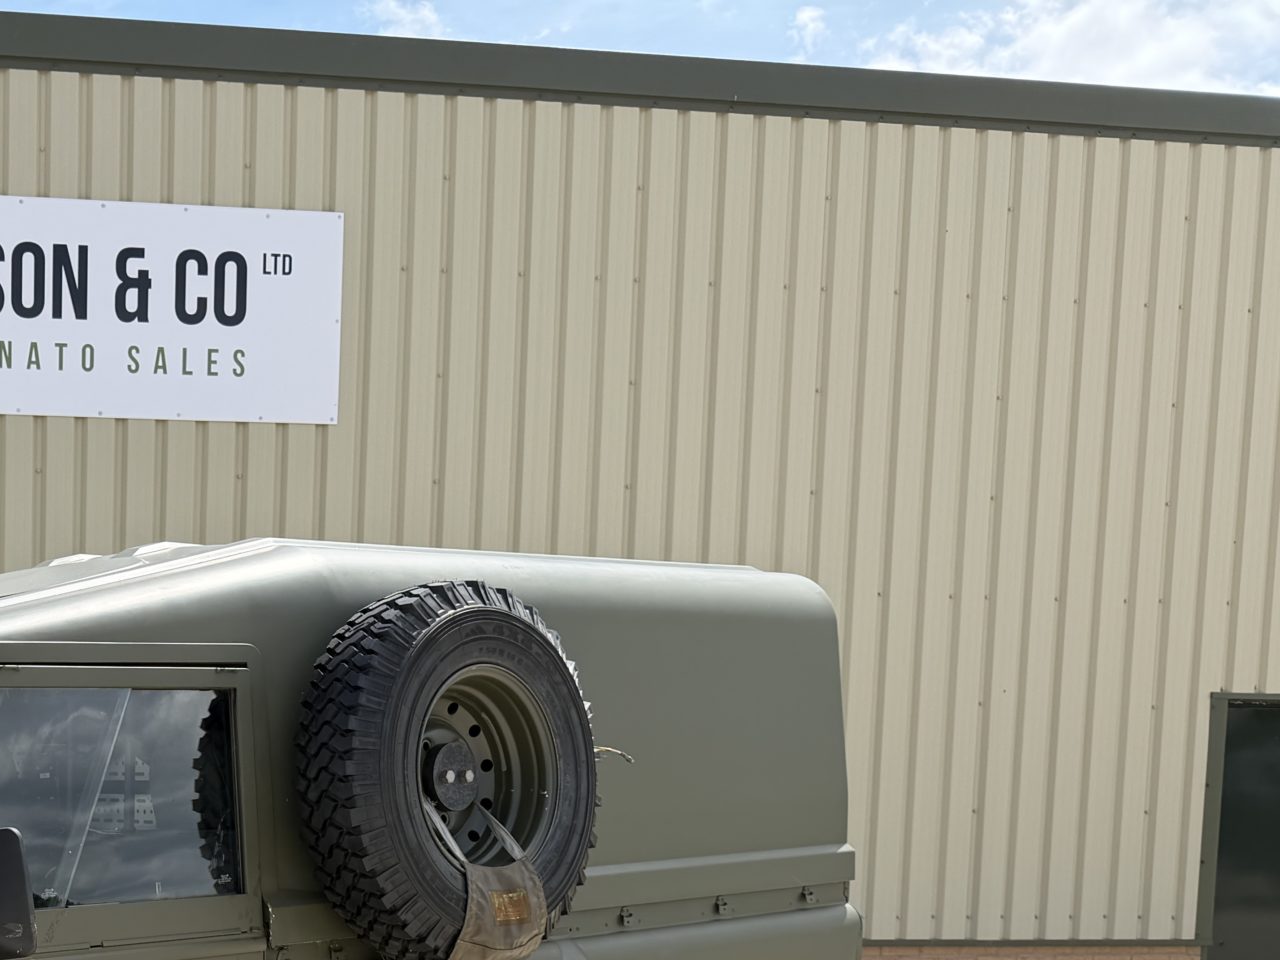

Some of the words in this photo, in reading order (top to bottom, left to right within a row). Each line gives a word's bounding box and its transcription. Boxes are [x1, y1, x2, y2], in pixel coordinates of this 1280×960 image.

[114, 246, 153, 324] &
[174, 248, 248, 328] CO
[262, 252, 293, 276] LTD
[127, 345, 246, 378] SALES
